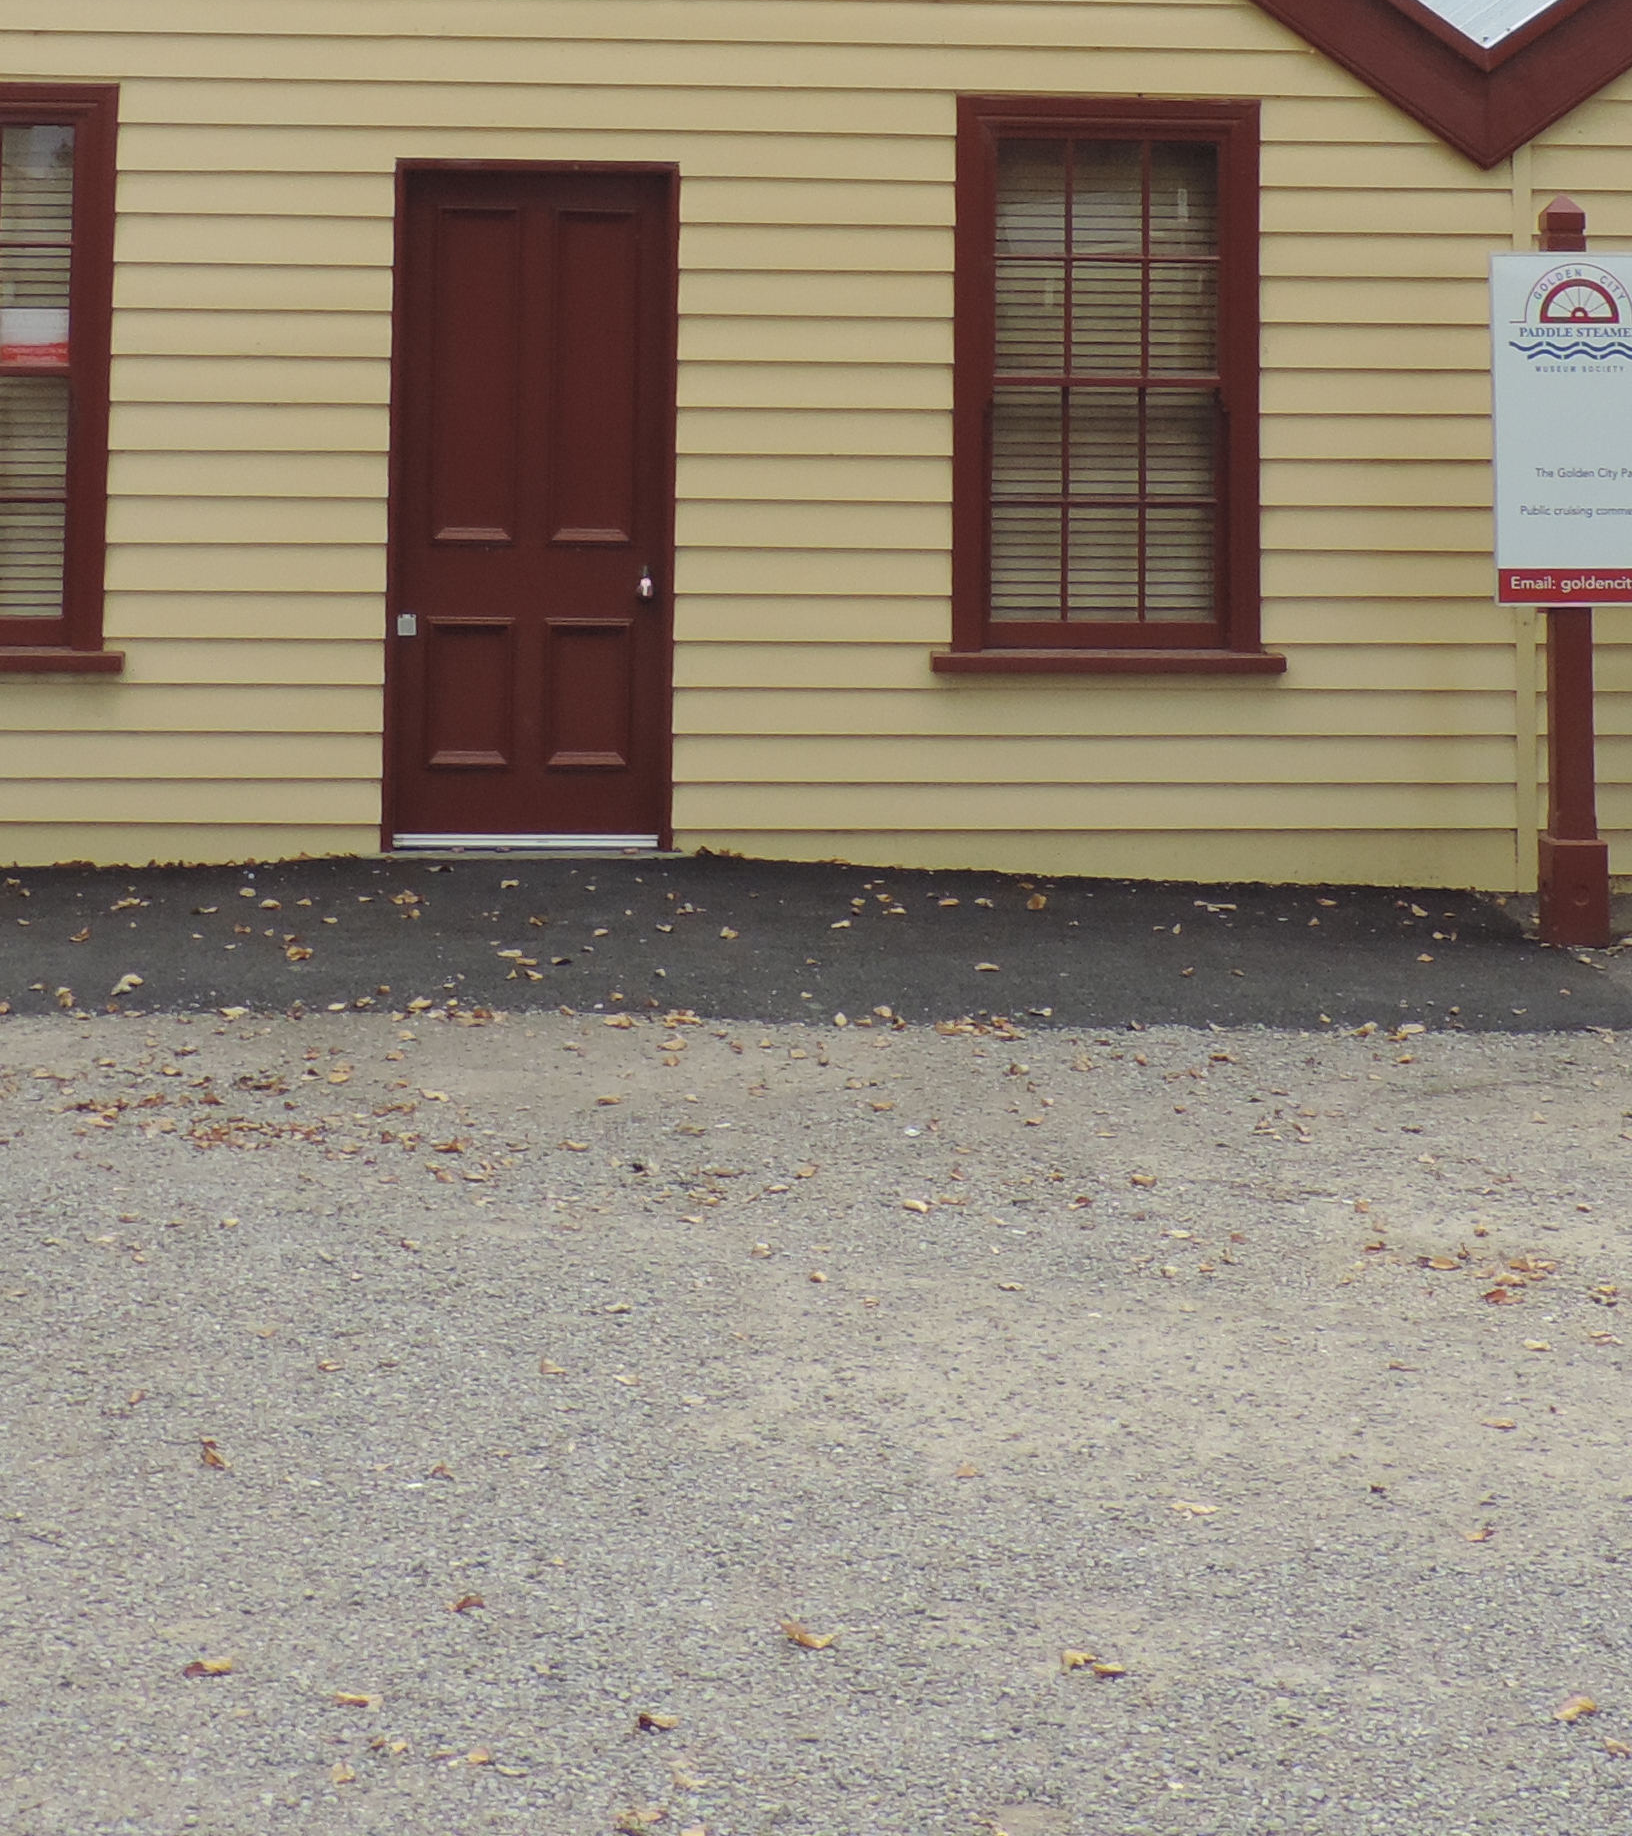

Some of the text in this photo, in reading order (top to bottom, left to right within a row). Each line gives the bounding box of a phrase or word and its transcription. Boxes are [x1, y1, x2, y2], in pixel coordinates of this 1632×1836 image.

[1533, 268, 1626, 300] GOLDEN CITY
[1519, 327, 1573, 338] PADDLE
[1535, 468, 1554, 478] The
[1557, 468, 1595, 478] Golden
[1598, 468, 1618, 481] City
[1520, 506, 1551, 516] Public
[1554, 506, 1593, 518] cruising
[1510, 577, 1557, 589] Email:
